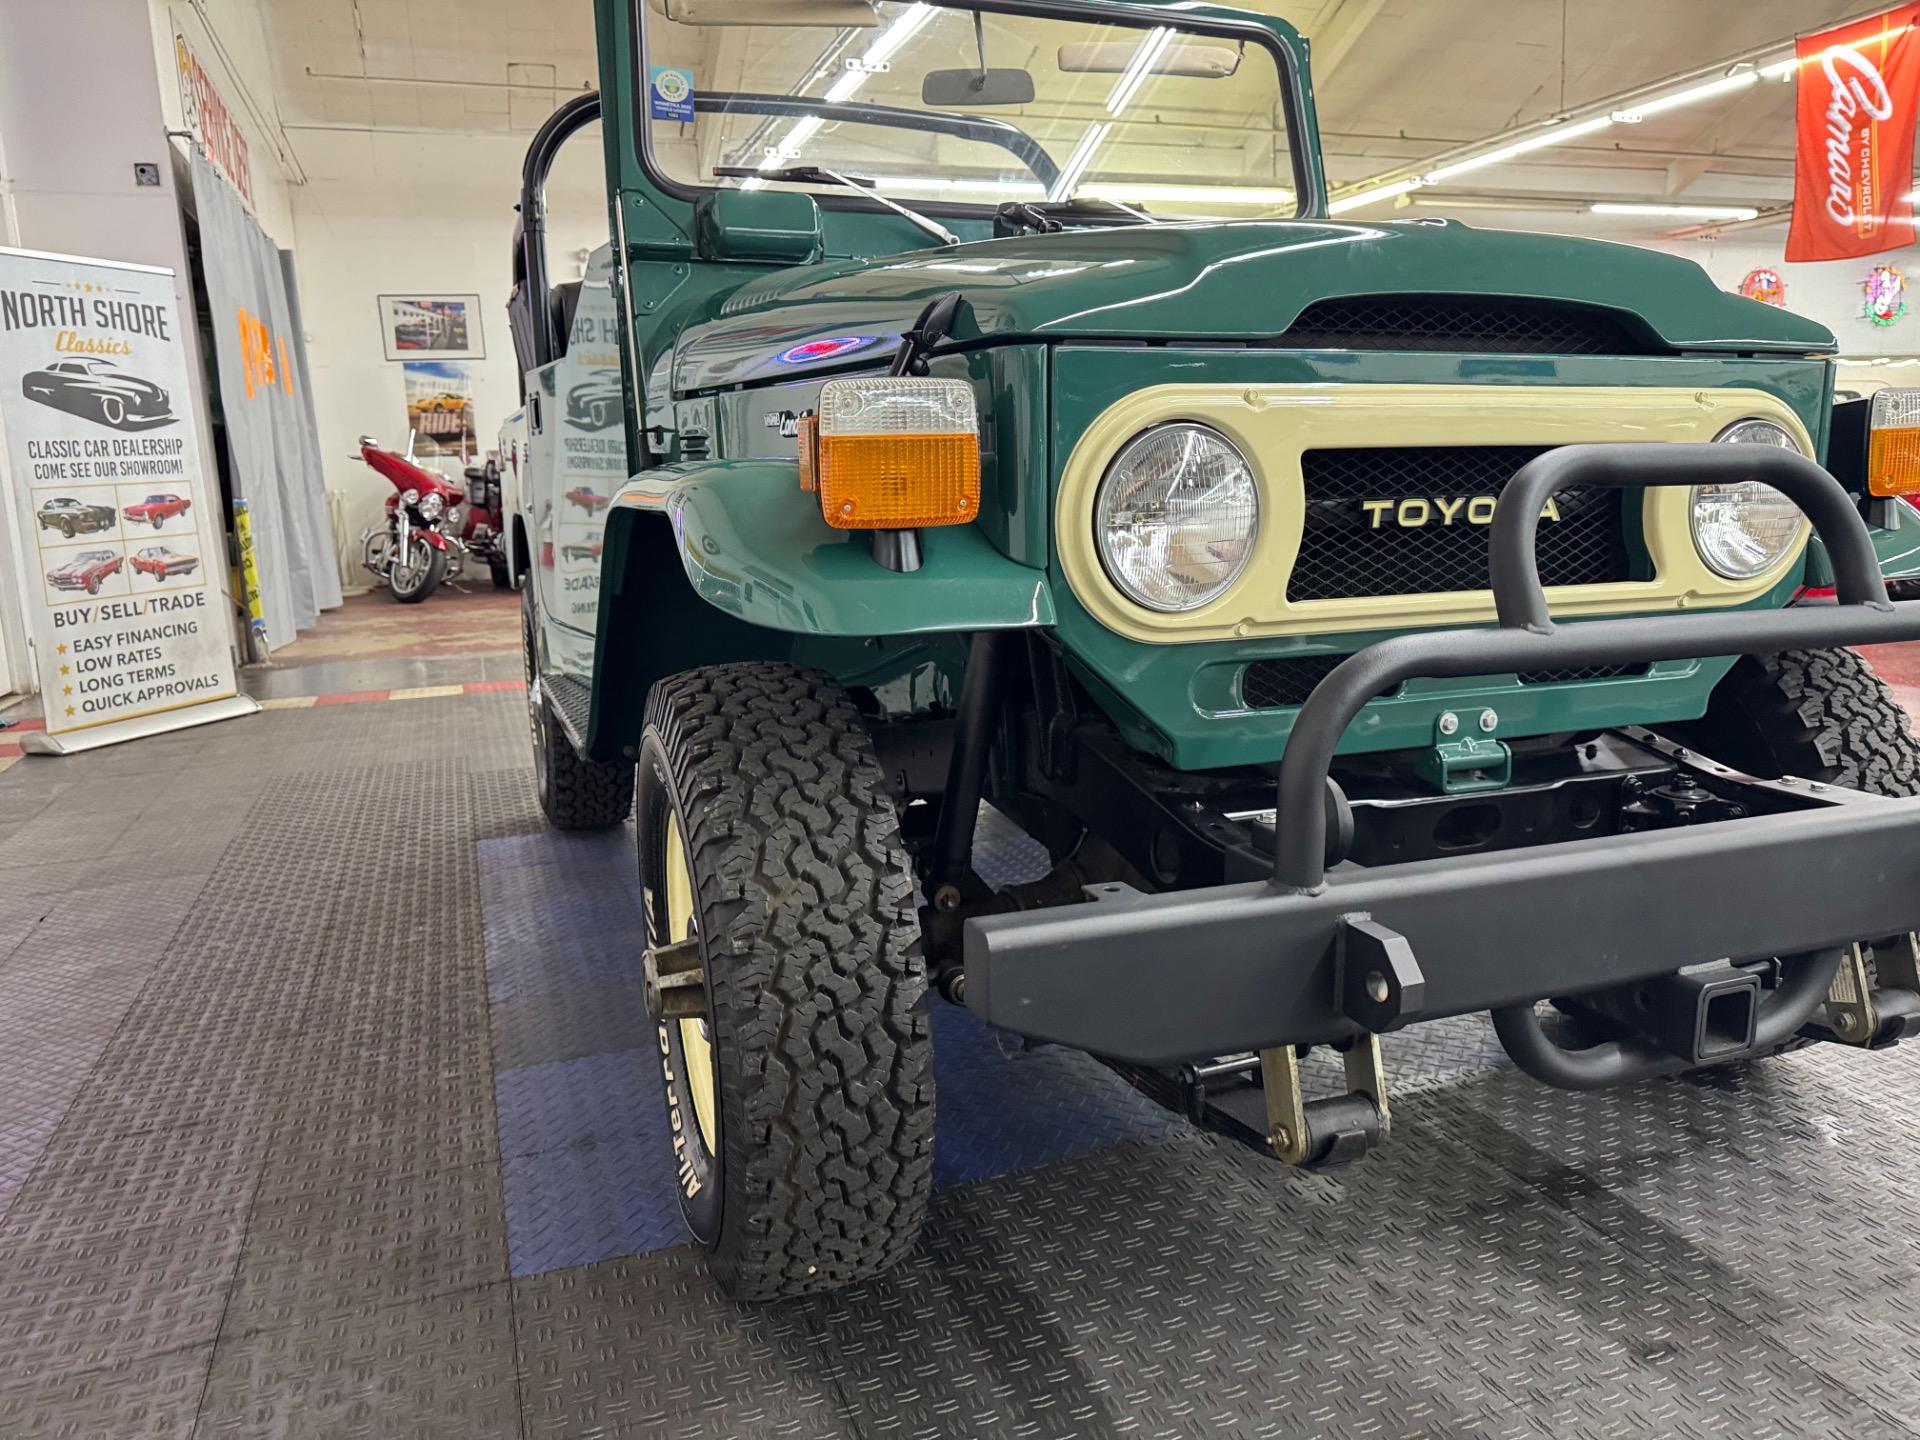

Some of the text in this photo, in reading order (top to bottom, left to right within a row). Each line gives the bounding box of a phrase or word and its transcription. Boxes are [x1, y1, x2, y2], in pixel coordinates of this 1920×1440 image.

[1821, 44, 1892, 227] Camaro
[1859, 127, 1874, 232] BY CHEVROLET
[0, 289, 171, 342] NORTH SHORE
[54, 330, 131, 356] Classics
[418, 412, 462, 434] RIDE
[28, 438, 184, 459] CLASSIC CAR DEALERSHIP
[34, 459, 184, 480] COME SEE OUR SHOWROOM!
[1362, 495, 1561, 529] TOYOA
[53, 592, 206, 628] BUY/SELL/TRADE
[73, 621, 199, 654] EASY FINANCING
[76, 647, 163, 674] LOW RATES
[79, 664, 176, 694] LONG TERMS
[82, 674, 220, 714] QUICK APPROVALS
